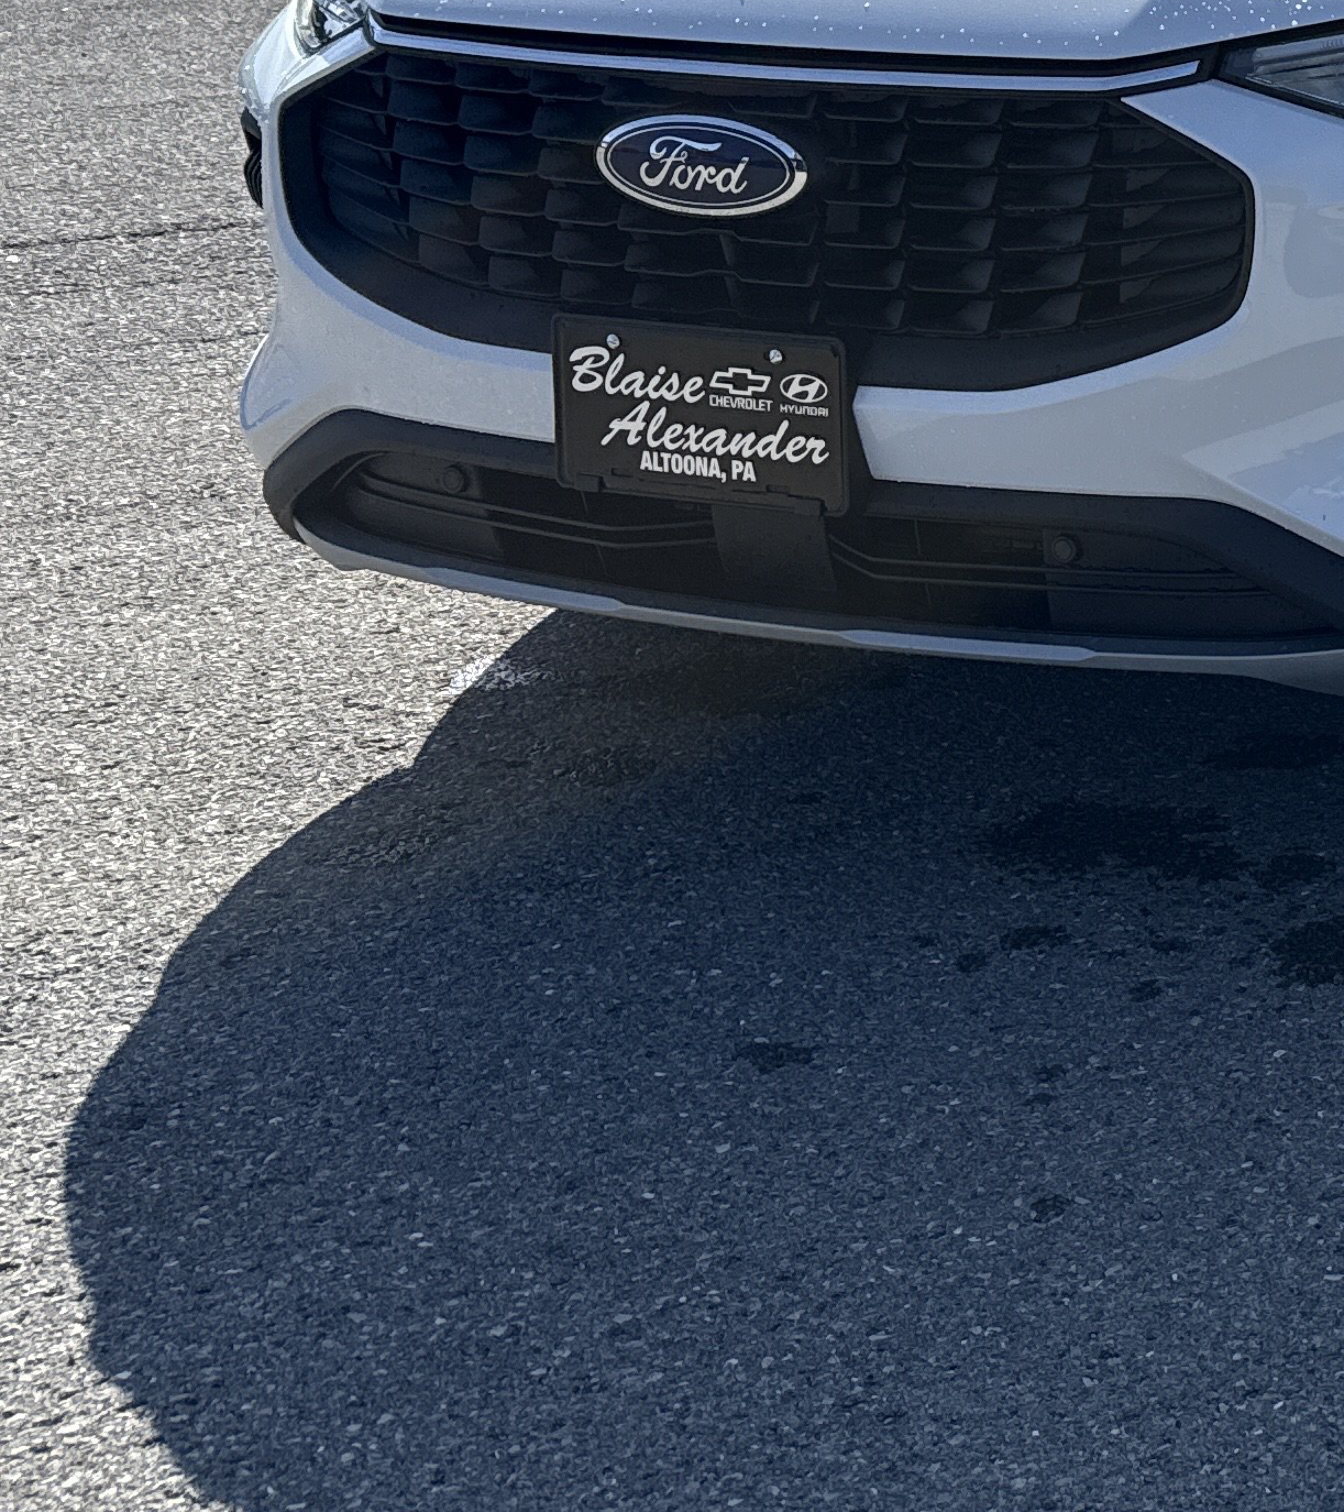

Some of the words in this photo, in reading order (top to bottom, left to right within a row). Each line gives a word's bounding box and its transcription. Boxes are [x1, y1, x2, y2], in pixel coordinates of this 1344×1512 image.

[639, 135, 749, 195] Ford
[569, 345, 706, 404] Blaise
[709, 394, 774, 412] CHEVROLET
[780, 403, 829, 418] HYUNDAI
[601, 401, 829, 465] Alexander
[640, 450, 727, 483] ALTOONA,
[731, 459, 757, 483] PA
